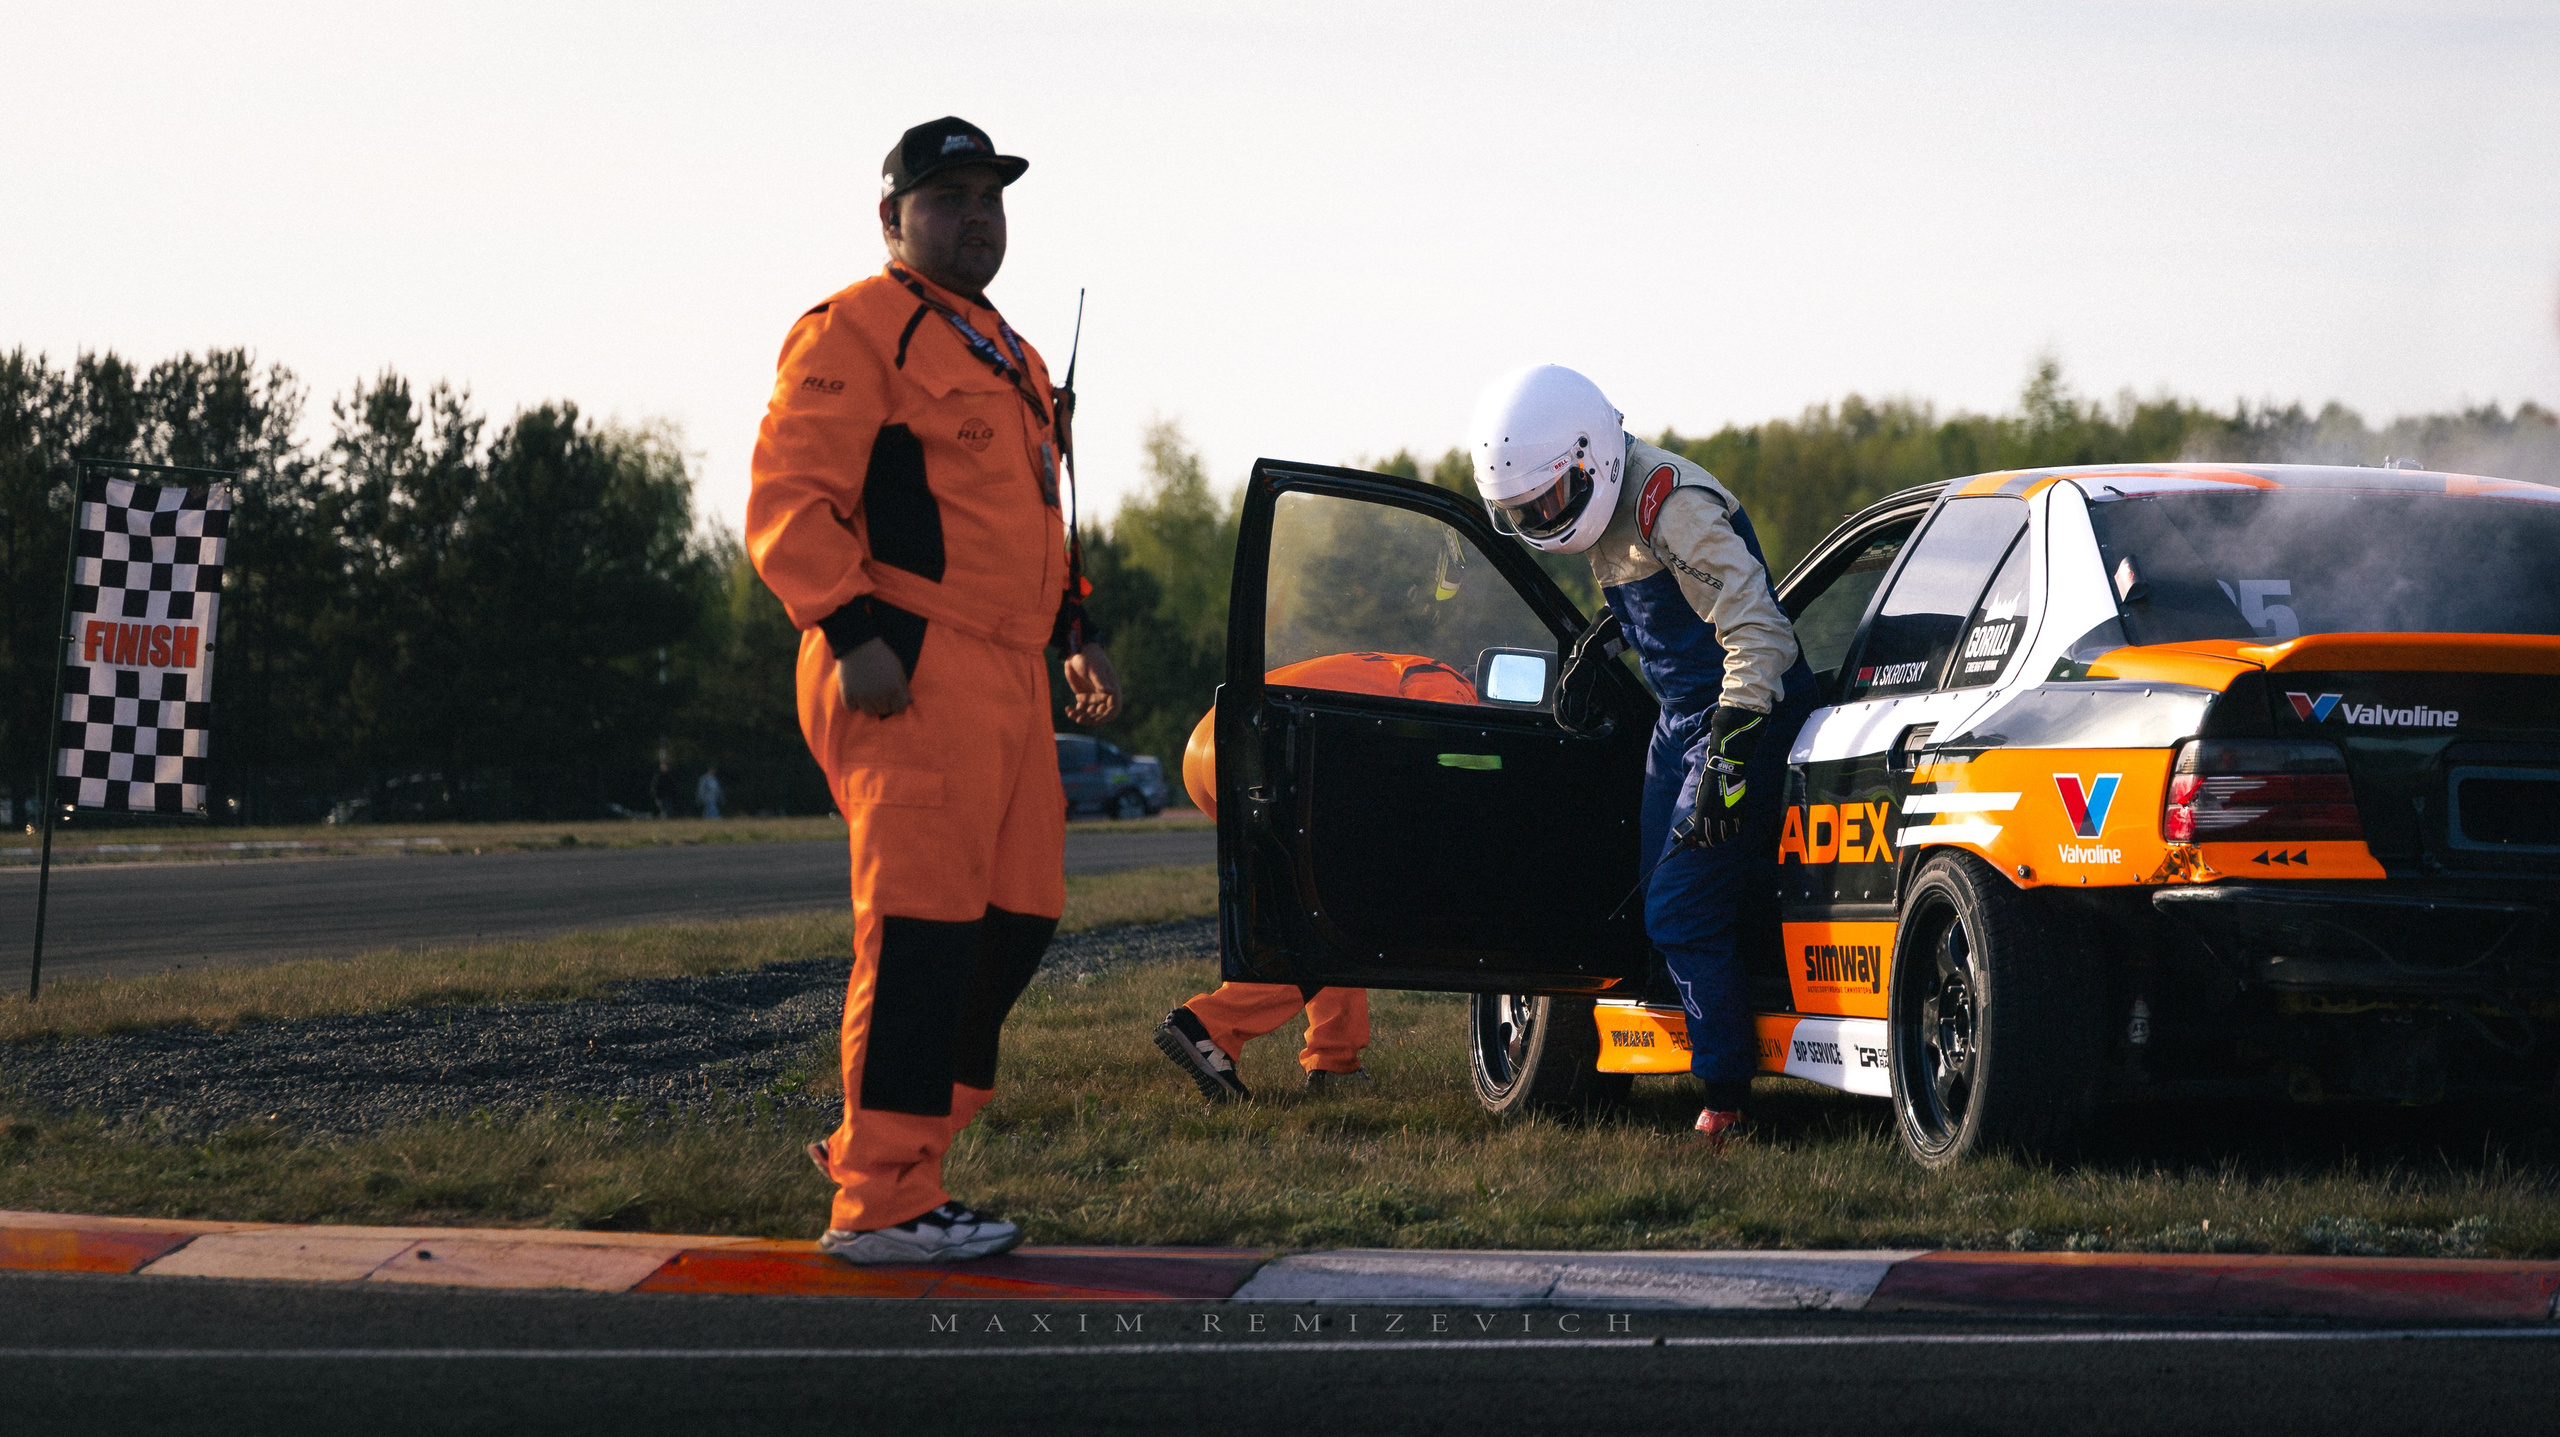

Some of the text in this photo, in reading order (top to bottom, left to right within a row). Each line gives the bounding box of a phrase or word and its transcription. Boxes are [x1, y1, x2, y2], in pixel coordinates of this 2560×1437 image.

[956, 427, 994, 440] RLG
[1554, 459, 1569, 470] BELL
[2216, 579, 2300, 638] 5
[83, 620, 199, 668] FINISH
[1964, 623, 2016, 659] GORILLA
[2341, 703, 2459, 728] Valvoline
[1778, 801, 1895, 865] ADEX
[2057, 843, 2123, 865] Valvoline
[1804, 944, 1881, 994] simway
[1793, 1040, 1843, 1065] BIP SERVICE
